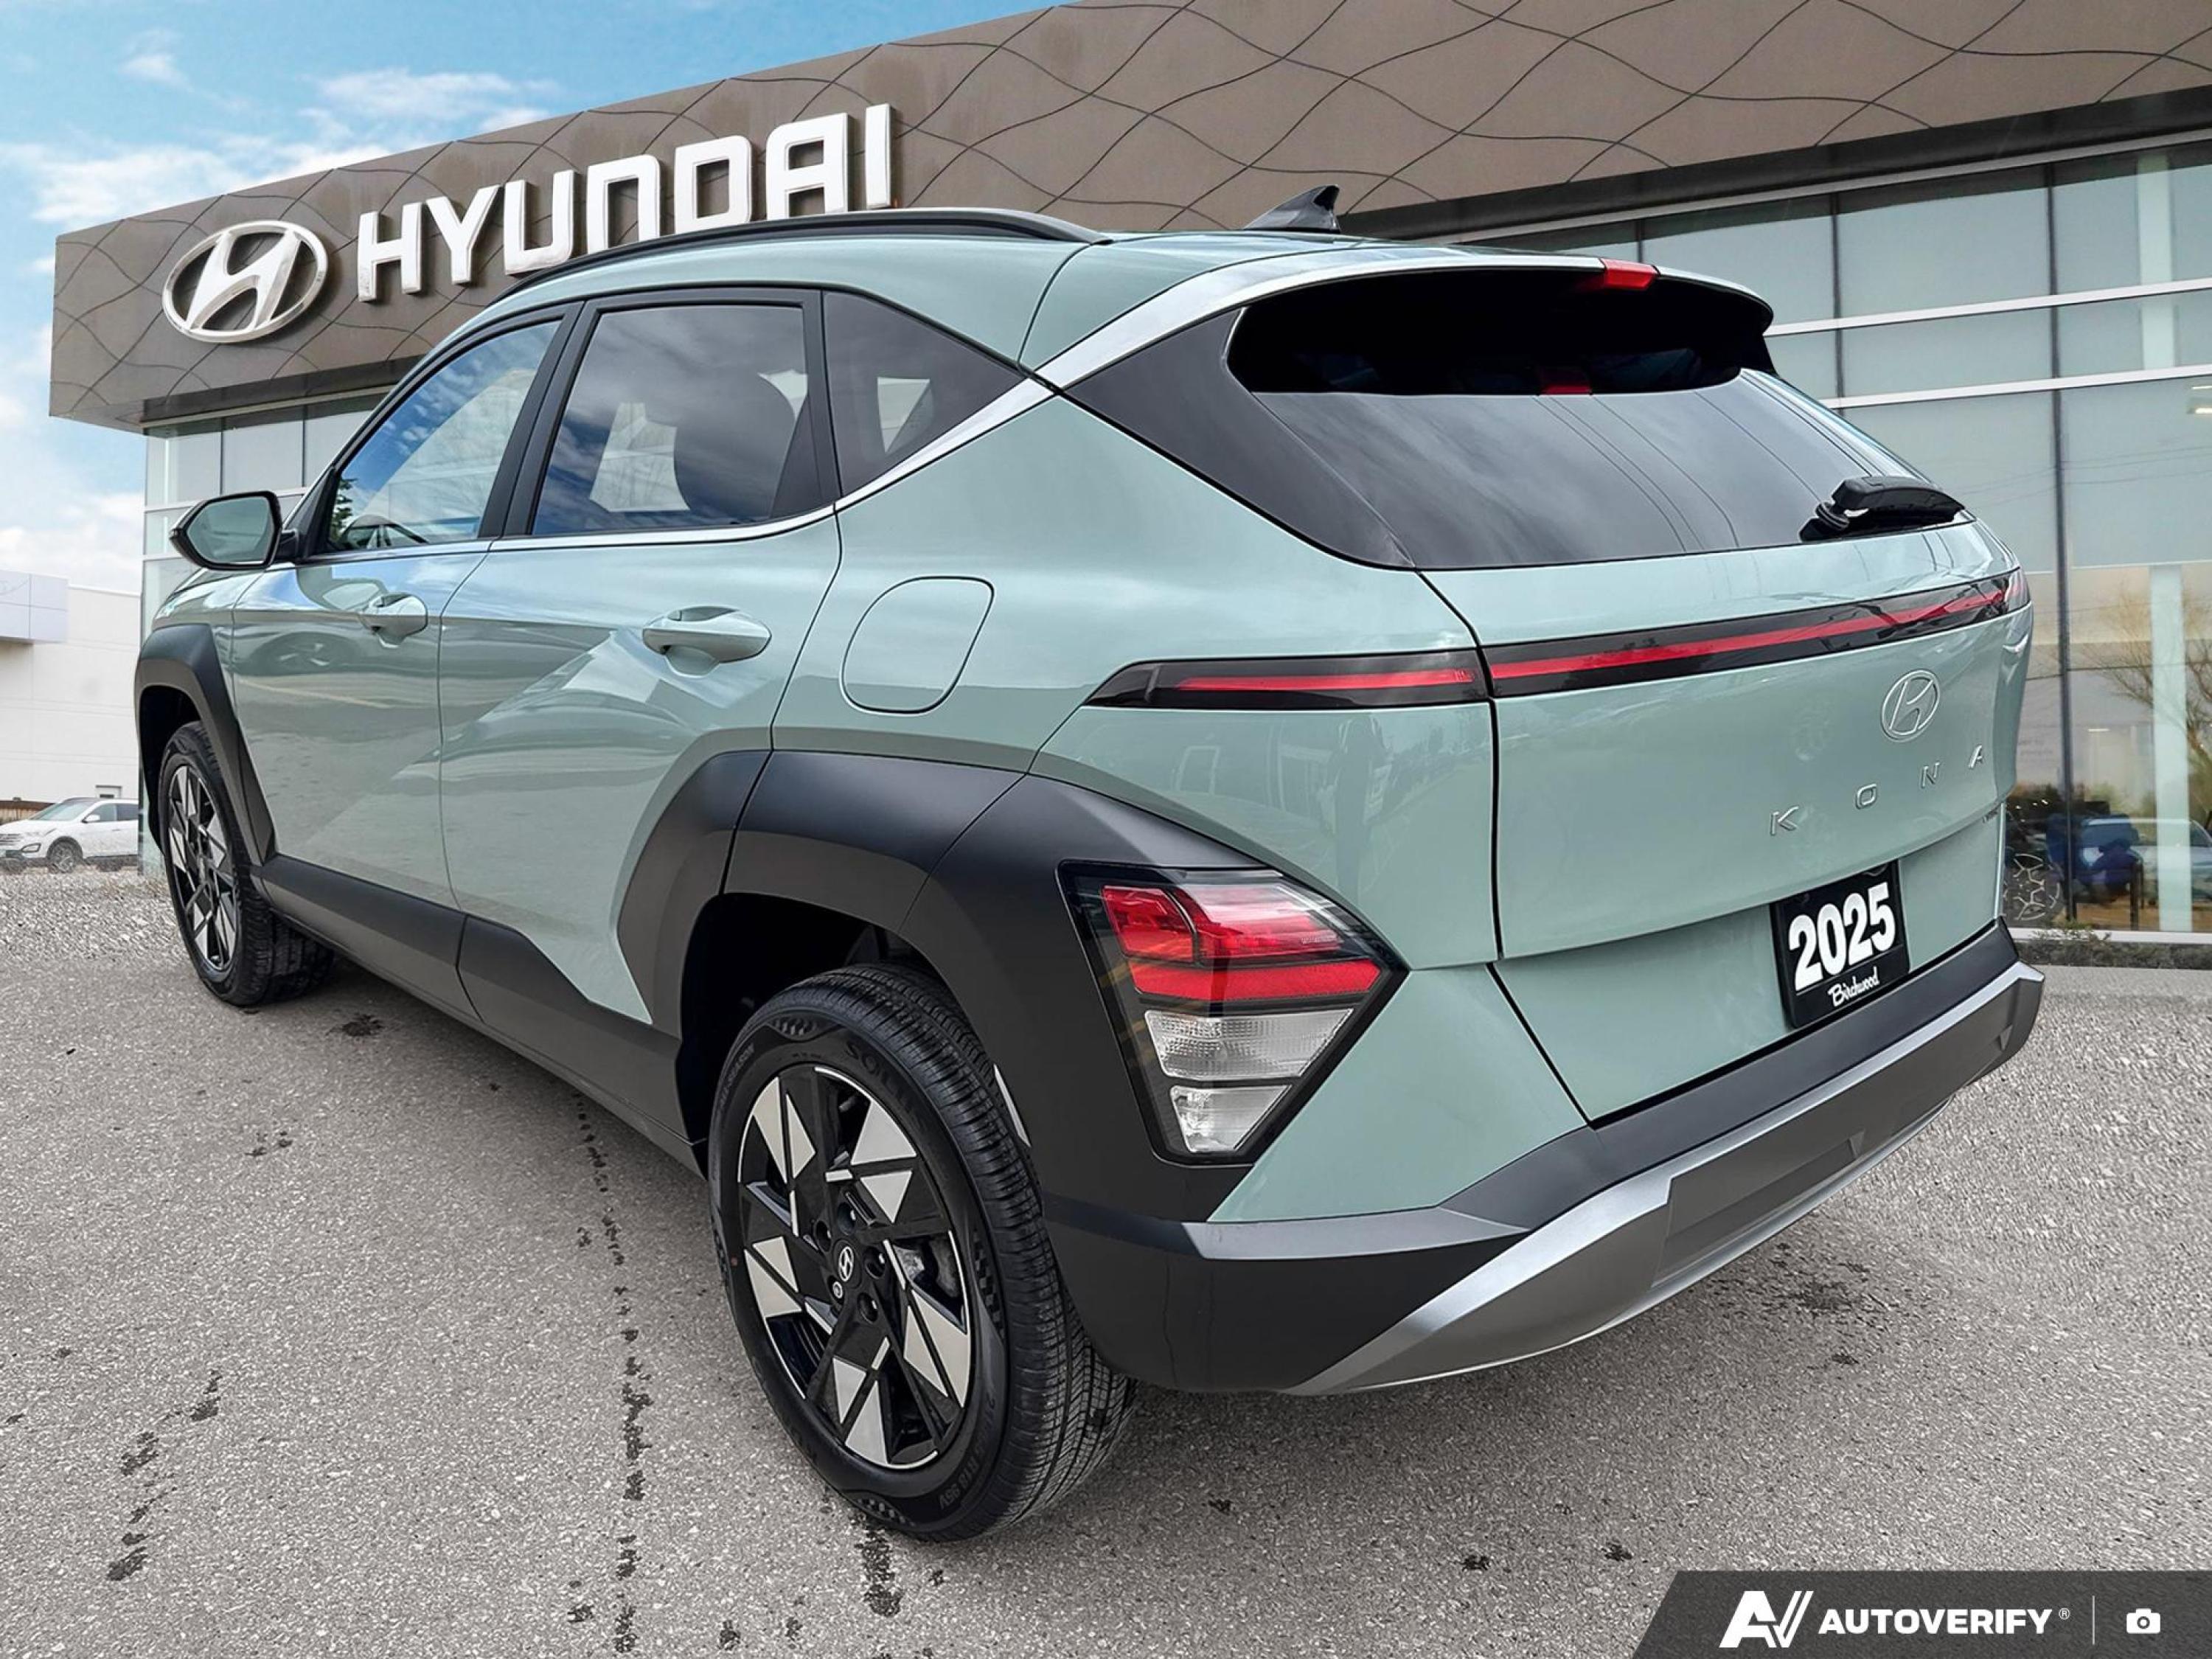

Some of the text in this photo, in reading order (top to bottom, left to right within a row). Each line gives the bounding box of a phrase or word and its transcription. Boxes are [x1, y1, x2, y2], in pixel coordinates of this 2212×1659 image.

[358, 103, 891, 303] HYUNDAI
[1770, 744, 1984, 836] KONA
[1788, 881, 1896, 992] 2025
[1826, 966, 1881, 1008] Birchwood
